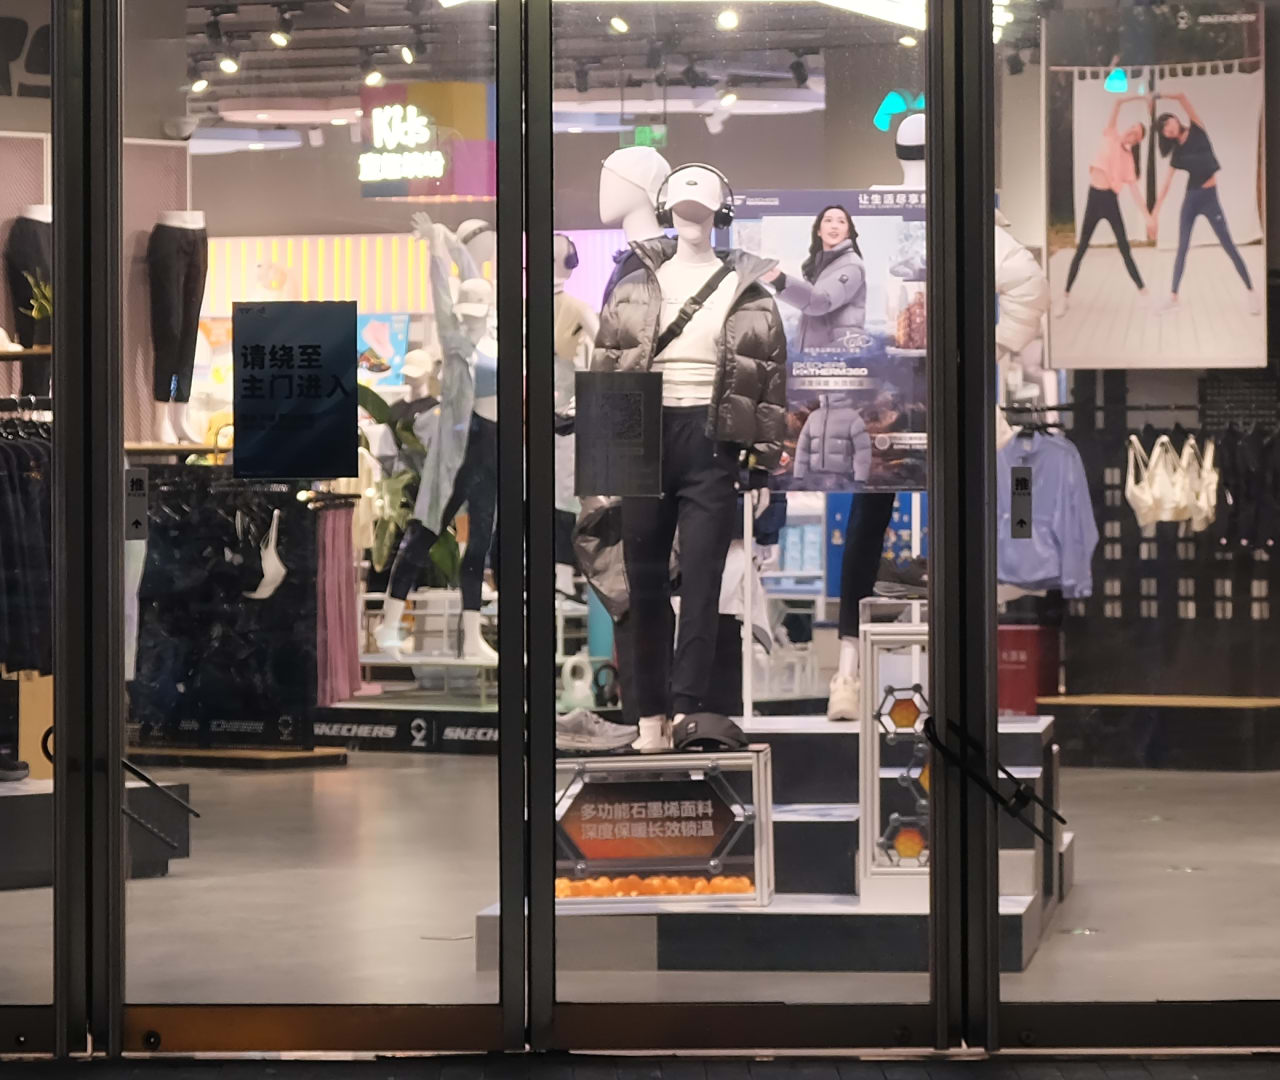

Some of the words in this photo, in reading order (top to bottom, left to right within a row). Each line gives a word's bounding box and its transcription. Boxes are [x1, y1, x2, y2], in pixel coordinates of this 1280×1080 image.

[240, 344, 323, 370] 请绕至
[240, 373, 350, 400] 主门进入
[580, 799, 715, 821] 多功能石墨烯面料
